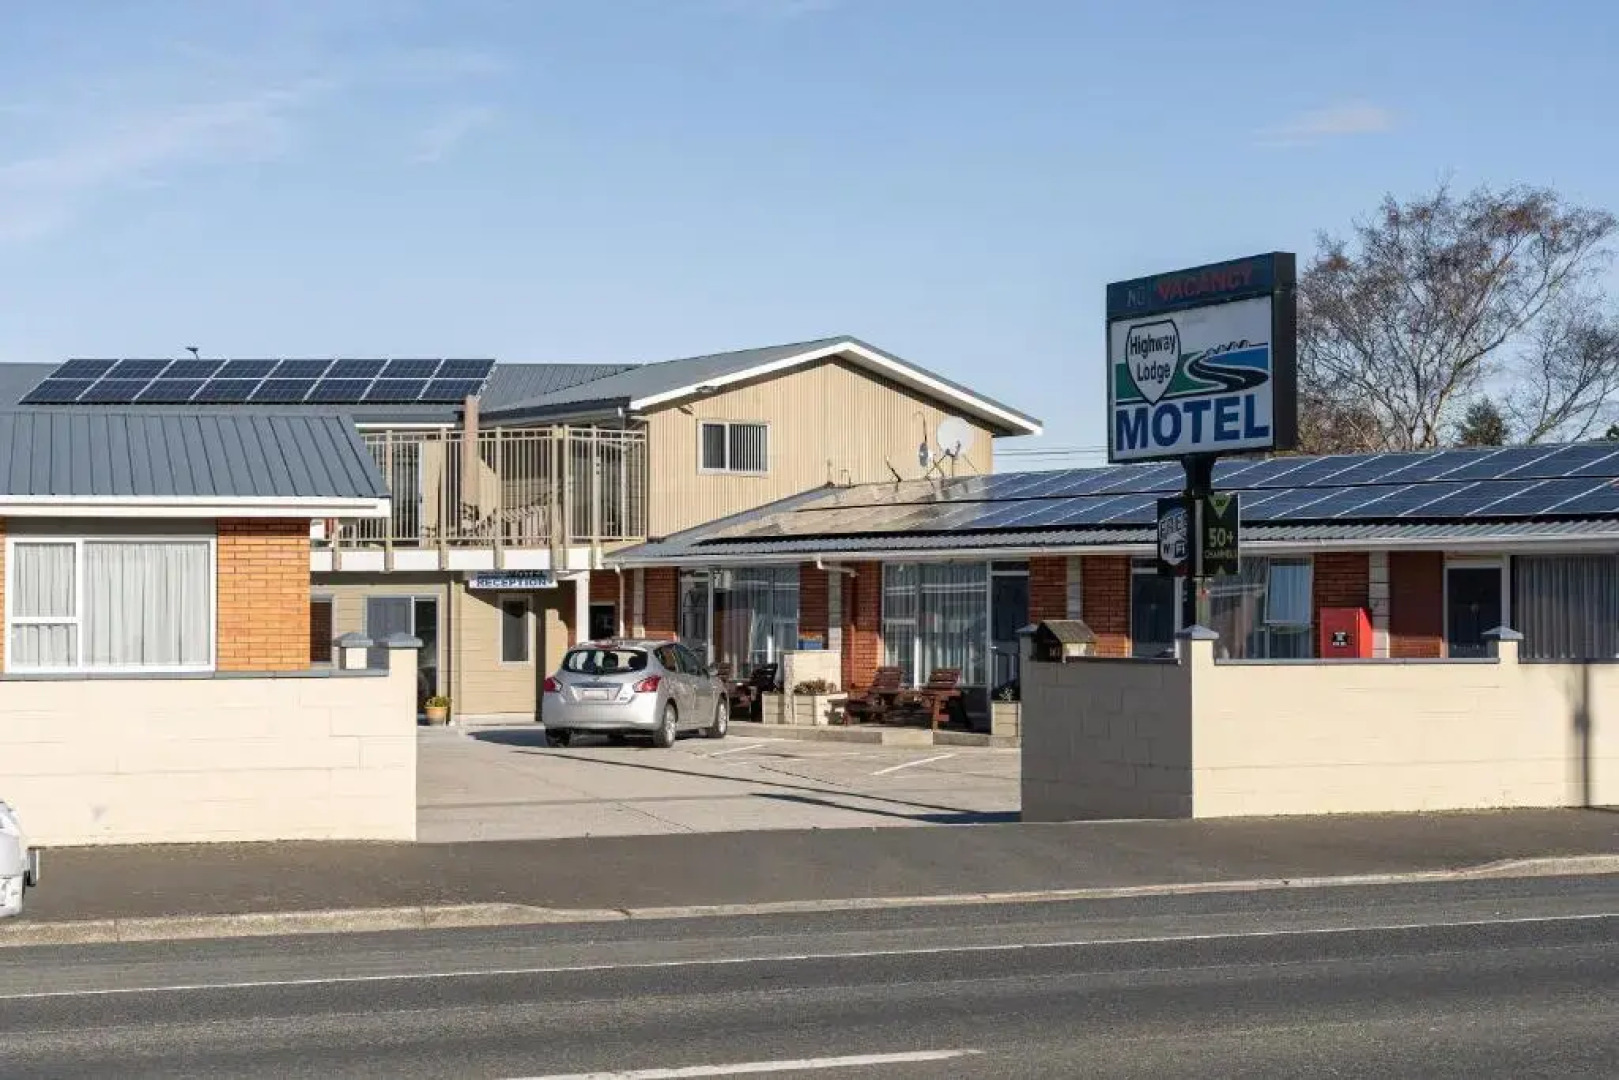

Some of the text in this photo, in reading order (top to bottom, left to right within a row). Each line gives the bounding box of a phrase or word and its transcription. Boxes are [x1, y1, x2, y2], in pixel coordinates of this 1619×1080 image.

[1157, 262, 1253, 300] VACANCY
[1130, 333, 1176, 359] Highway
[1137, 361, 1171, 384] Lodge
[1116, 394, 1269, 451] MOTEL
[1208, 527, 1234, 548] 50+
[477, 577, 547, 587] RECEPTION
